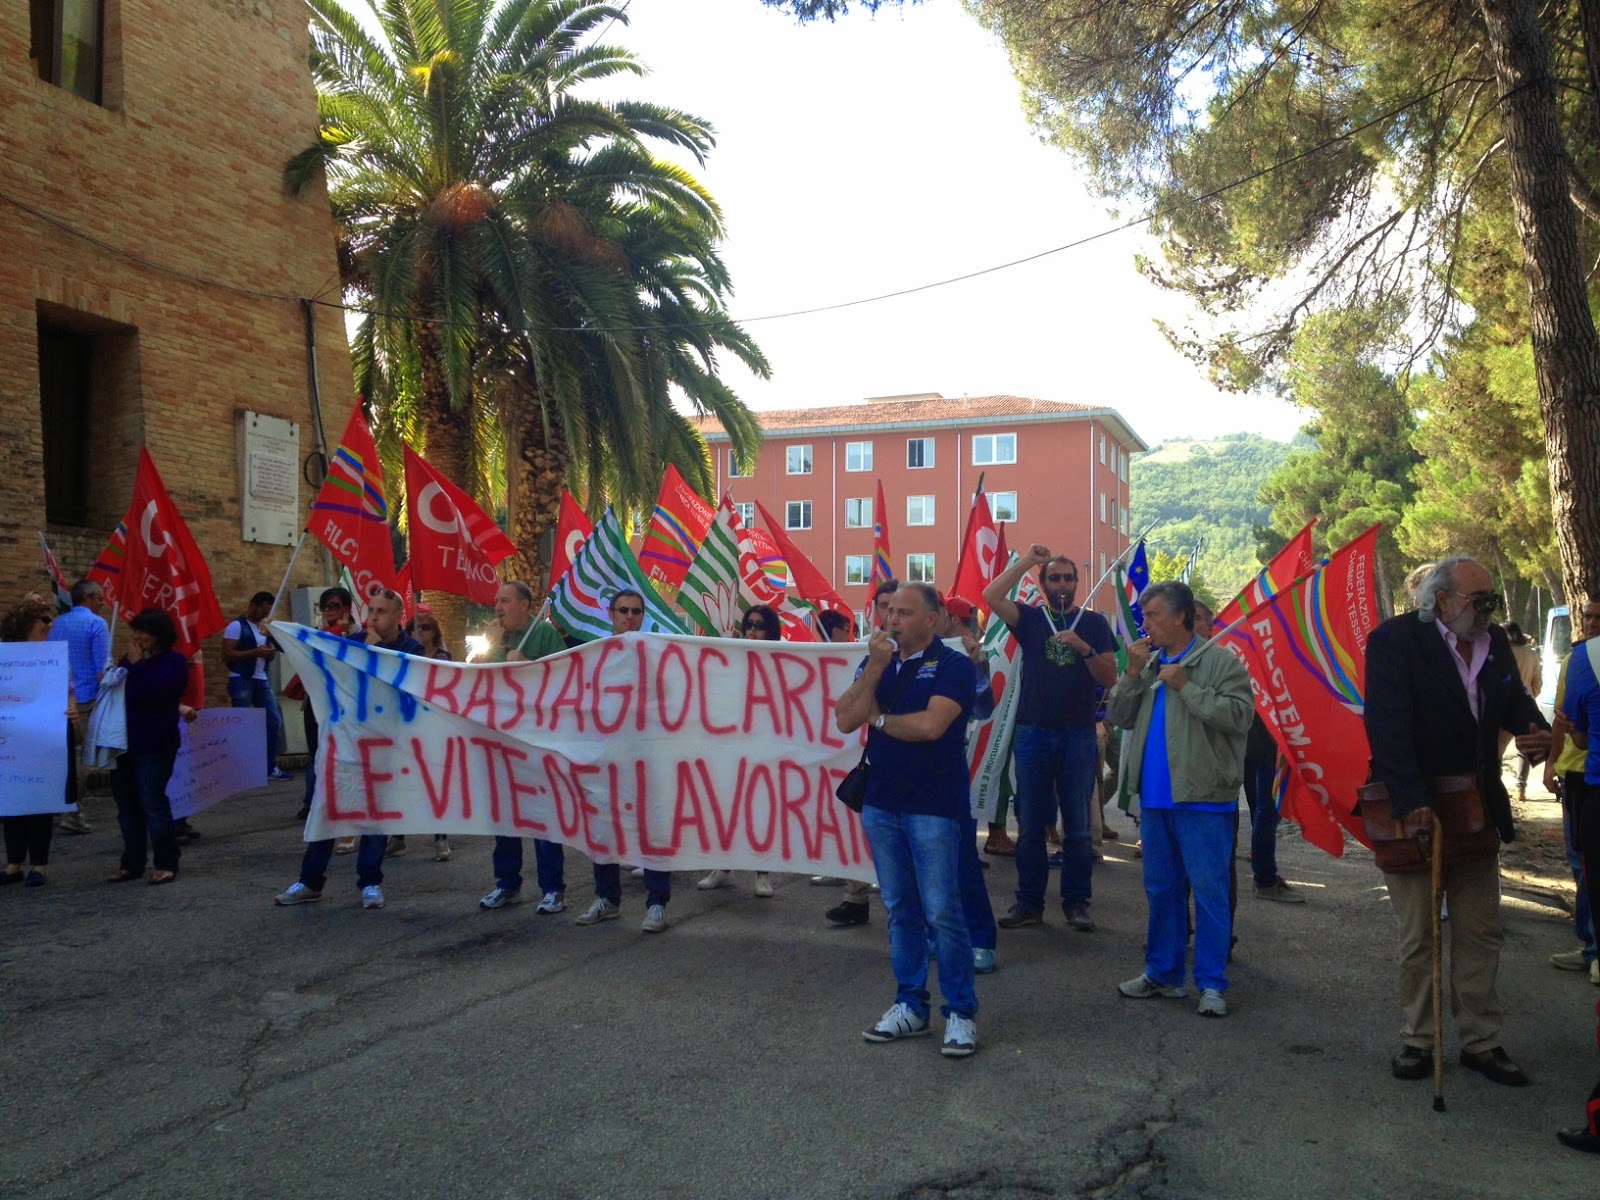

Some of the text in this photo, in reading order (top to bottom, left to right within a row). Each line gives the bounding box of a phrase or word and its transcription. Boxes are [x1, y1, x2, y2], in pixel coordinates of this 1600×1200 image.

[324, 732, 405, 824] LE
[409, 734, 549, 832] VITE
[542, 752, 628, 858] DEI
